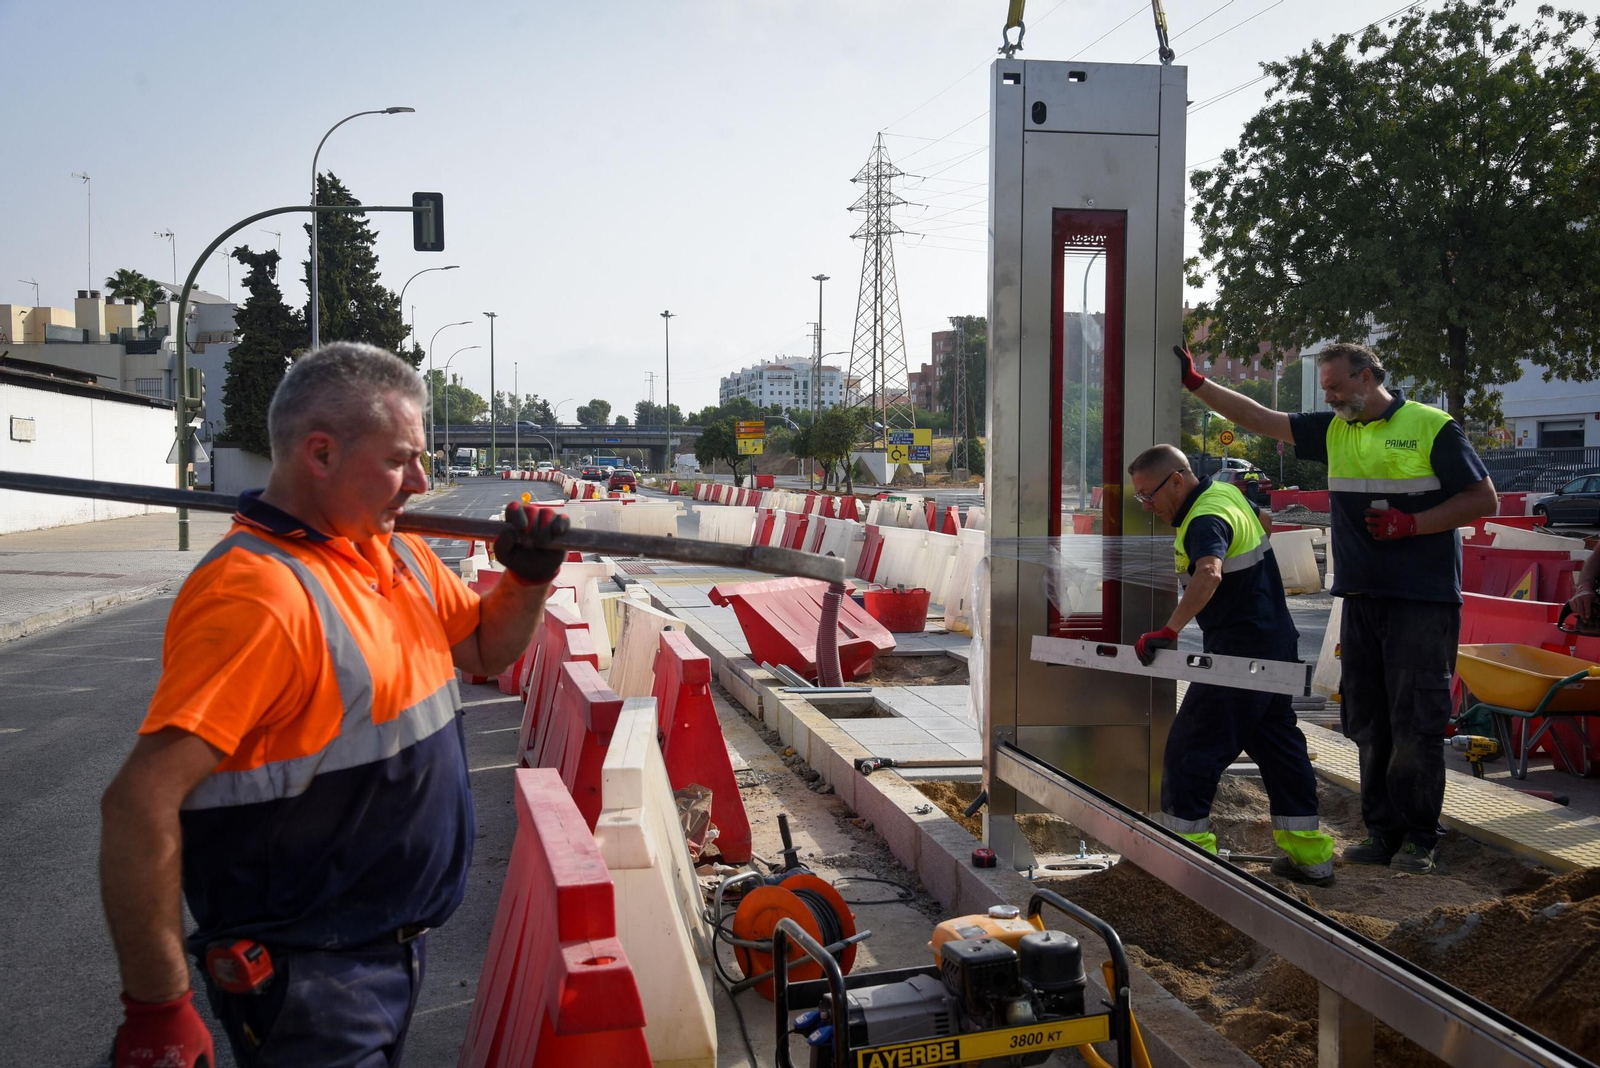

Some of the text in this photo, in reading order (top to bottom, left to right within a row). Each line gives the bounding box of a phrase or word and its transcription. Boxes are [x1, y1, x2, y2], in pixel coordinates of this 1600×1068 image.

[867, 1030, 1063, 1068] AYERBE 3800 KT
